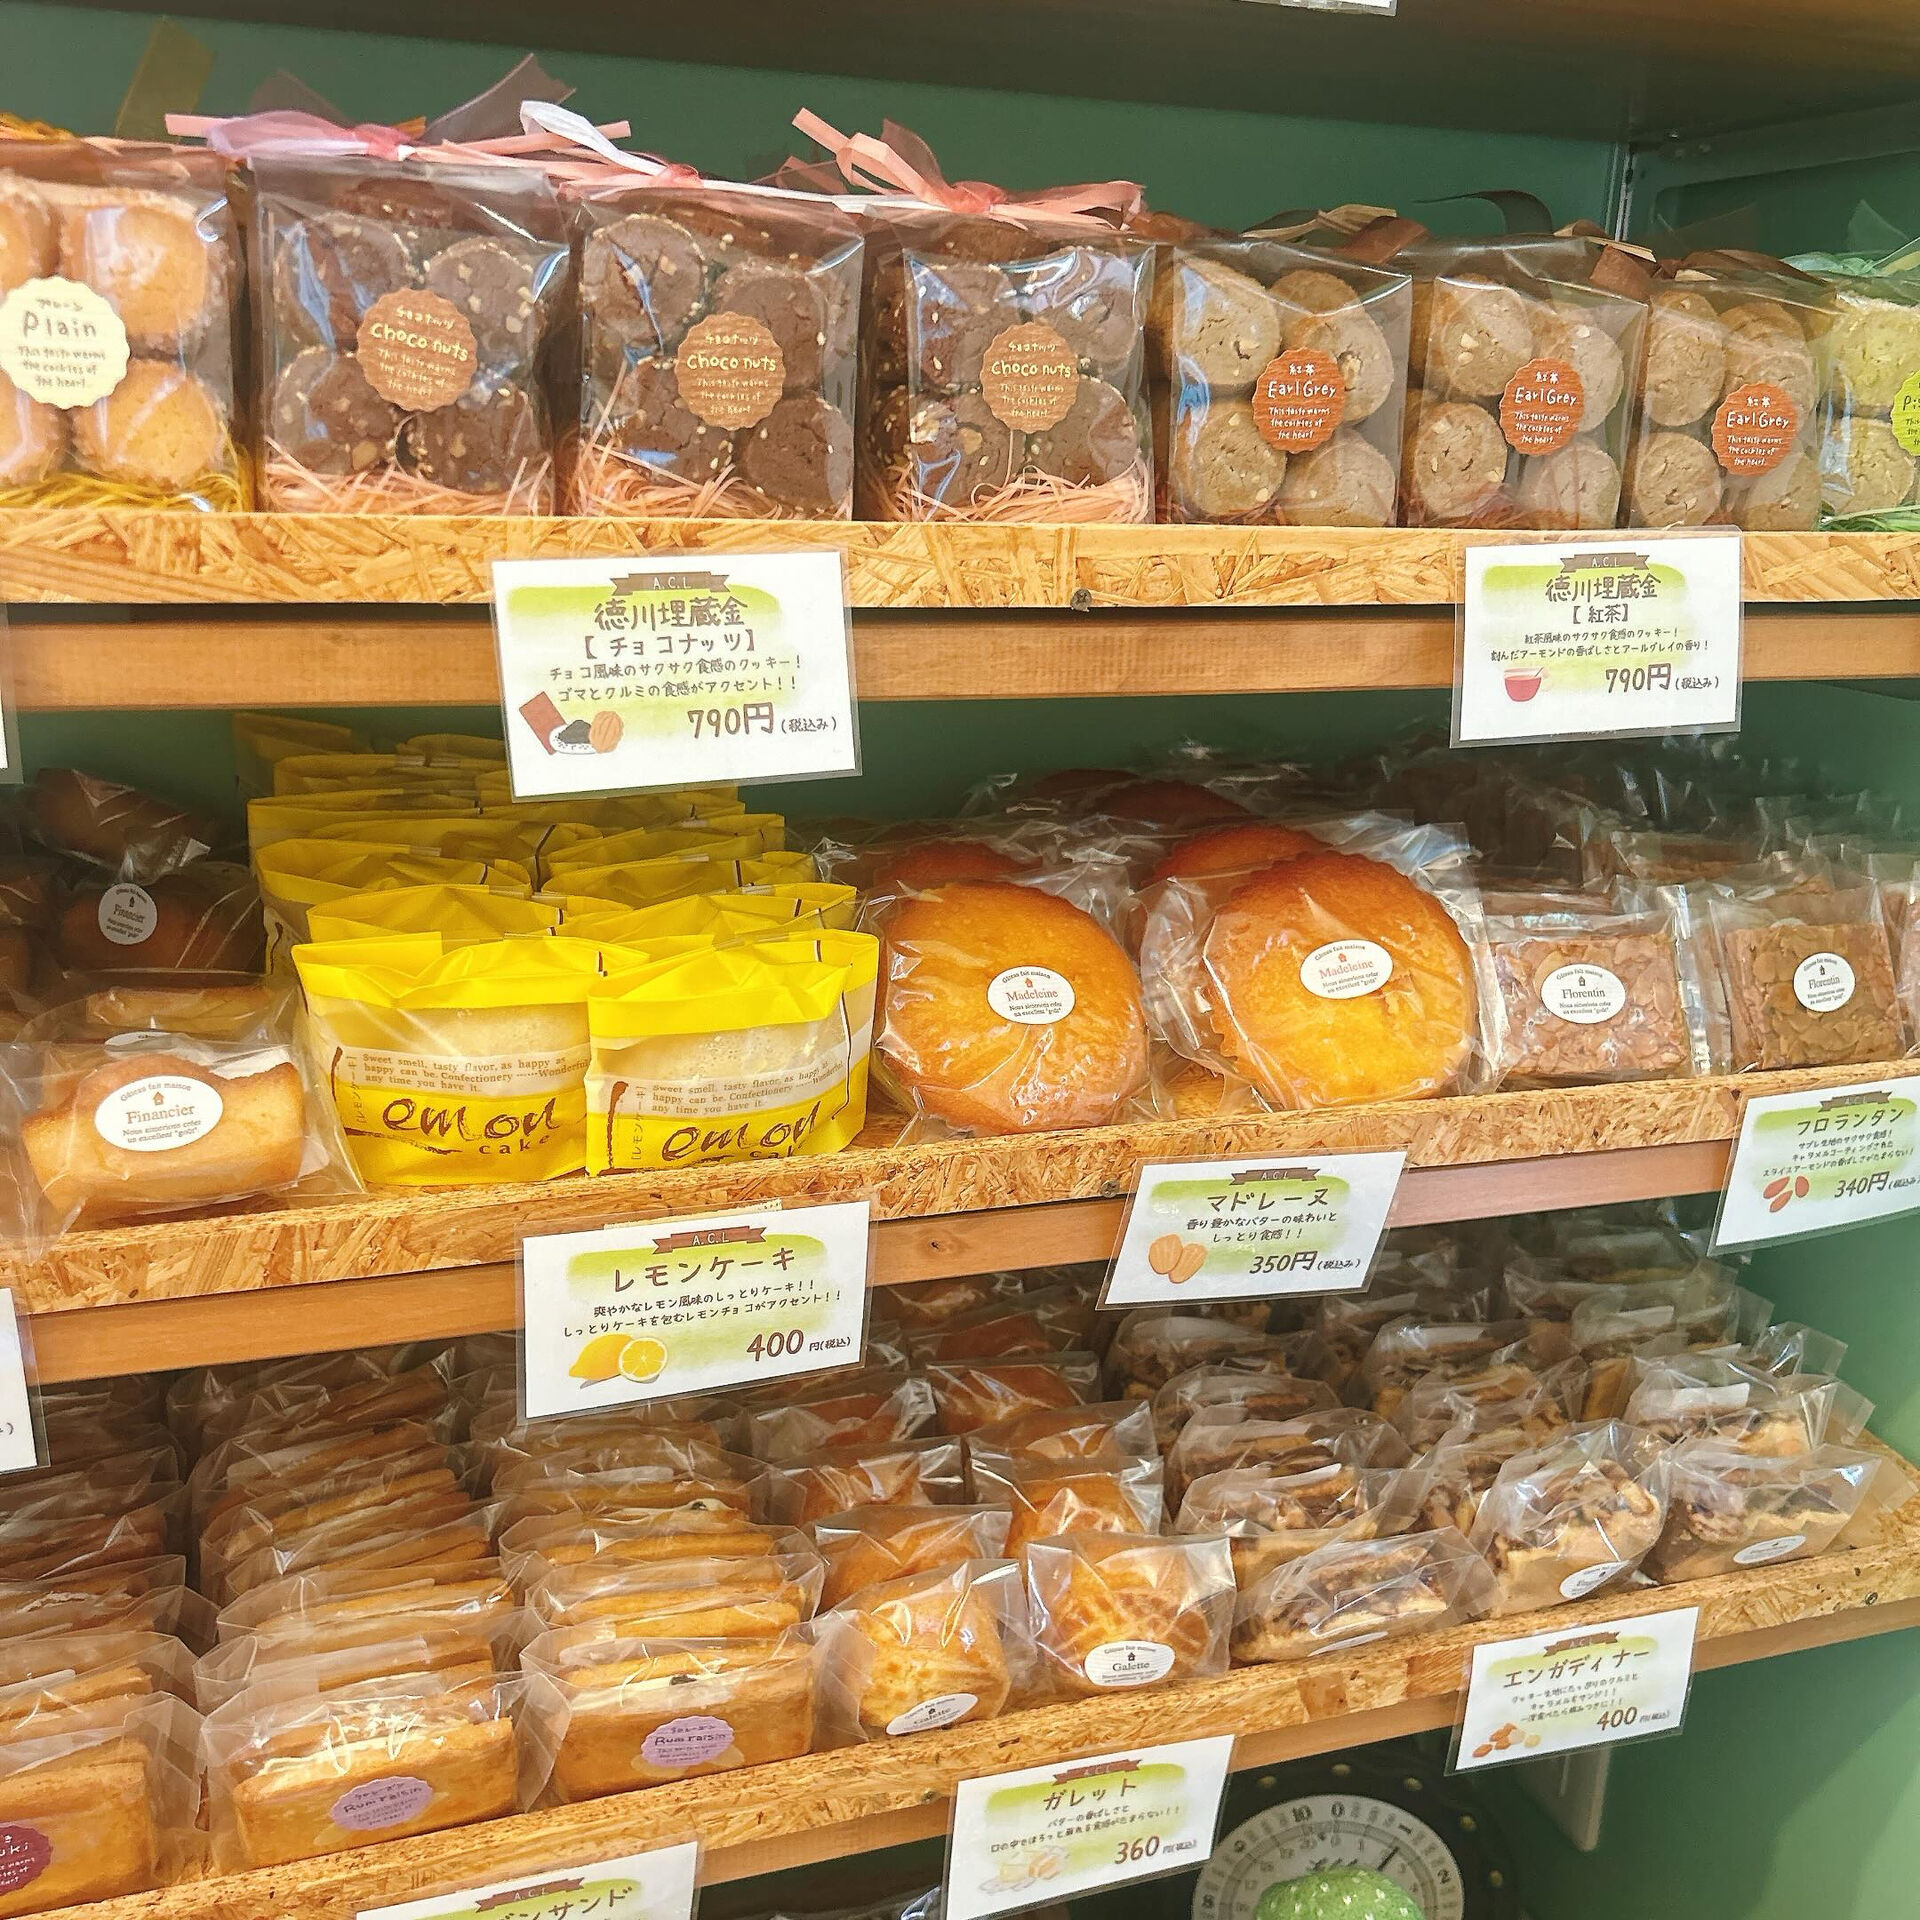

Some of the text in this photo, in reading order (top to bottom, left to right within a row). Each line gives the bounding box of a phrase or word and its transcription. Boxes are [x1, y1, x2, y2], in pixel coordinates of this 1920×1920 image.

[23, 311, 97, 338] Plain
[370, 322, 469, 361] Choco nuts
[687, 353, 777, 371] Choco nuts
[991, 360, 1072, 378] Choco nuts
[1268, 380, 1336, 398] Earl Grey
[1514, 386, 1576, 406] Earl Grey
[1726, 411, 1789, 428] Earl Grey
[1545, 573, 1662, 602] 徳川埋蔵金
[594, 596, 749, 632] 徳川埋蔵金
[1319, 960, 1374, 979] Madeleine
[1006, 987, 1059, 1001] Madeleine
[1562, 986, 1606, 999] Florentin
[362, 1053, 392, 1064] Sweet
[433, 1061, 458, 1073] tasty
[501, 1062, 512, 1070] as
[518, 1058, 551, 1070] happy
[364, 1063, 393, 1075] happy
[400, 1068, 418, 1076] can
[441, 1072, 513, 1084] Confectionery
[365, 1074, 384, 1084] any
[388, 1075, 412, 1086] time
[416, 1079, 436, 1090] you
[441, 1080, 465, 1090] have
[652, 1084, 683, 1094] Sweet
[652, 1094, 685, 1105] happy
[689, 1096, 706, 1104] can
[652, 1104, 669, 1114] any
[675, 1104, 699, 1114] time
[704, 1106, 722, 1115] you
[727, 1102, 750, 1111] have
[126, 1104, 196, 1124] Financier
[1797, 1108, 1905, 1136] フロランタン
[478, 1134, 550, 1156] cake
[1207, 1188, 1329, 1213] マドレーヌ
[1186, 1211, 1338, 1231] 香り豊かなバターの味わいと
[614, 1246, 796, 1293] レモンケーキ
[593, 1279, 814, 1318] 爽やかなレモン風味のしっとりケーキ！！
[746, 1329, 805, 1362] 400
[1112, 1662, 1150, 1672] Galette
[1503, 1649, 1650, 1689] エンガディナー
[1597, 1706, 1638, 1731] 400
[1043, 1777, 1137, 1812] ガレット
[1113, 1835, 1160, 1865] 360
